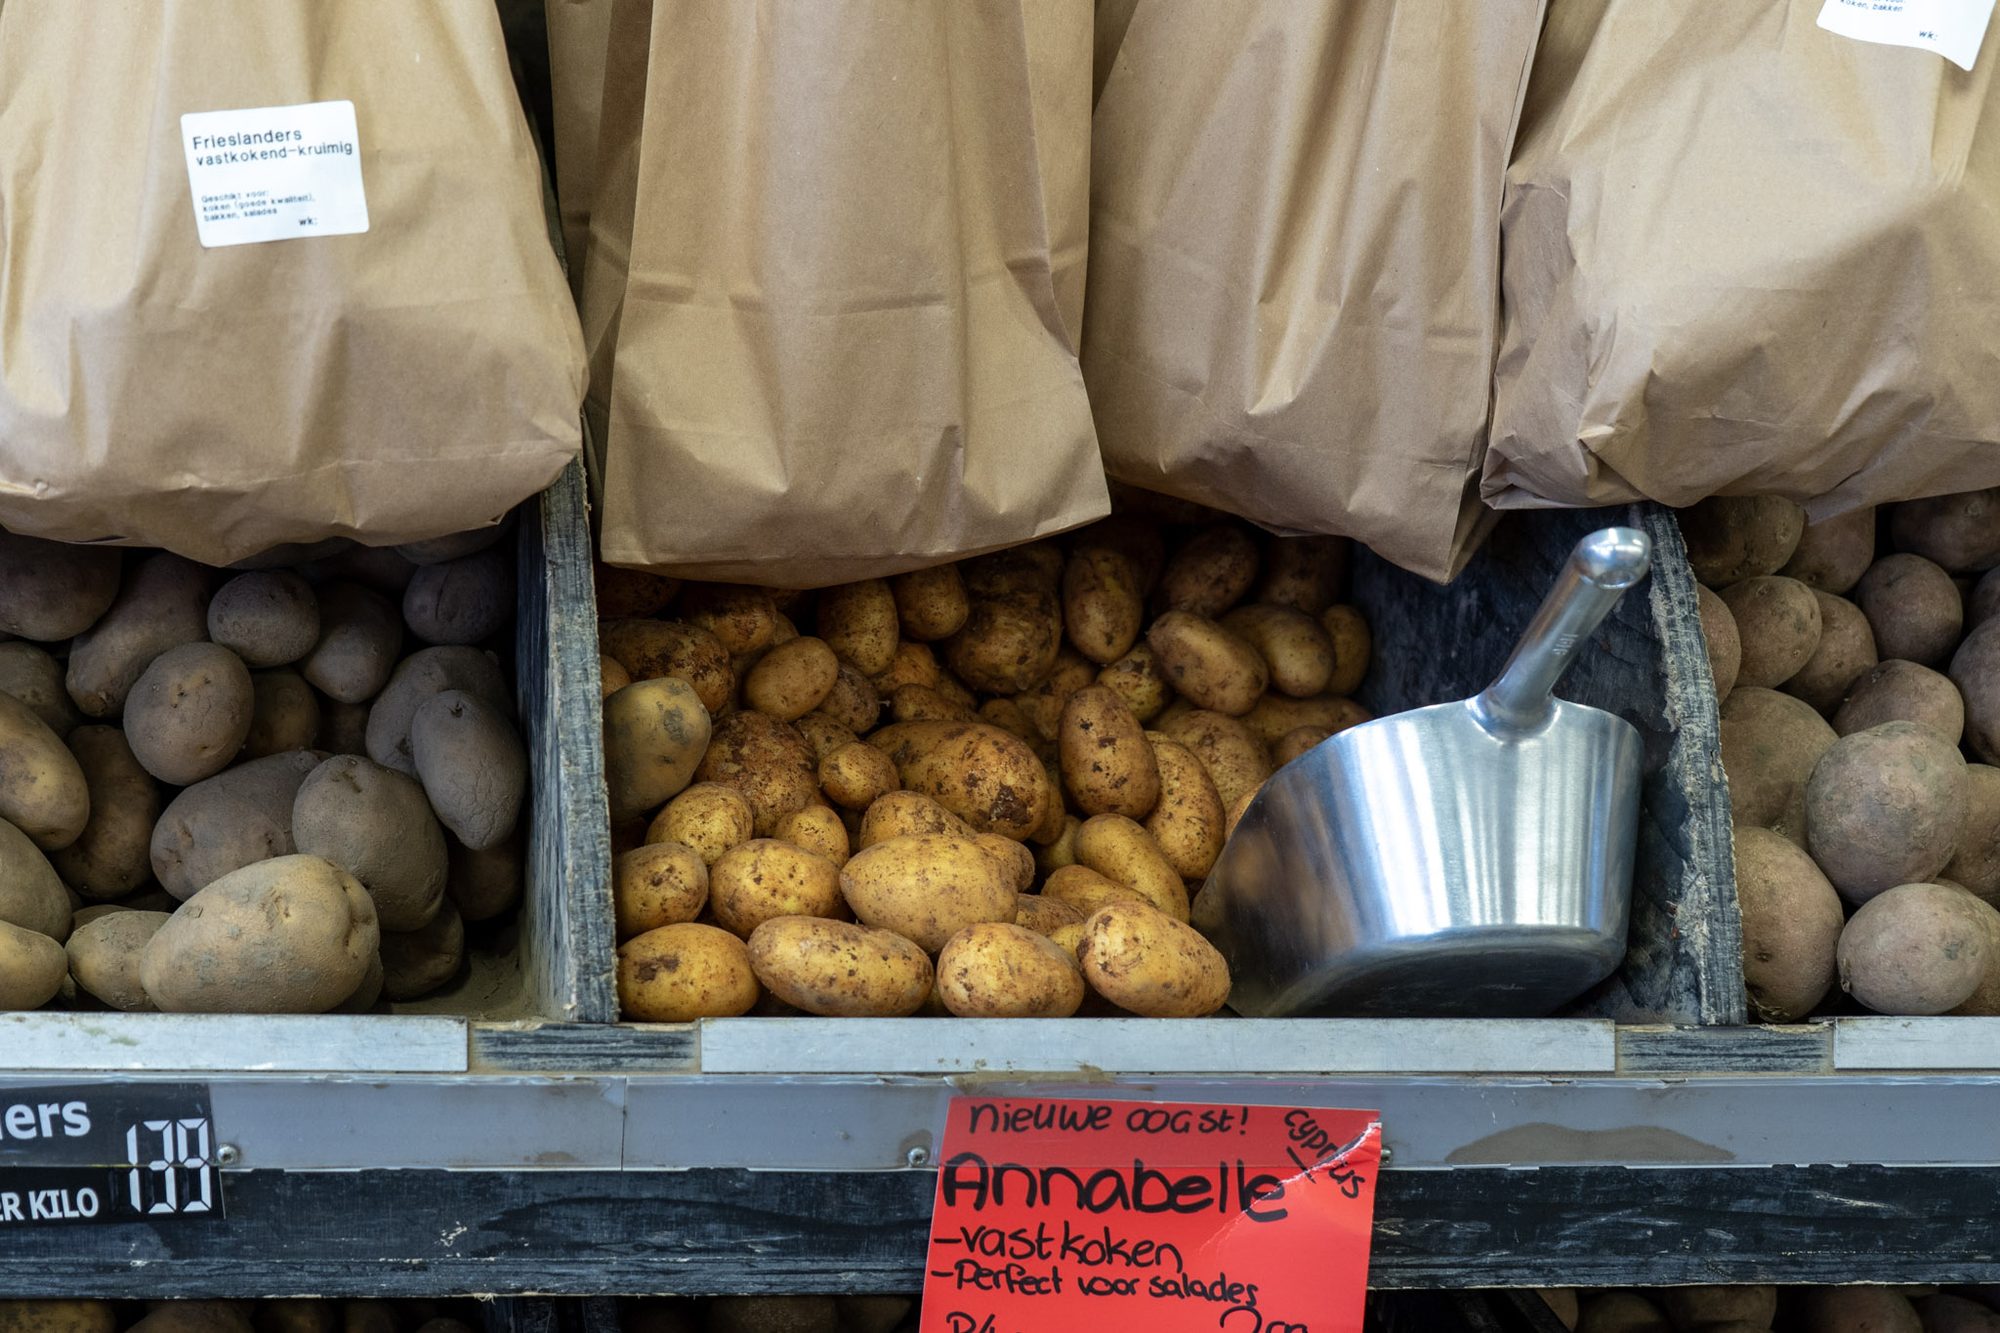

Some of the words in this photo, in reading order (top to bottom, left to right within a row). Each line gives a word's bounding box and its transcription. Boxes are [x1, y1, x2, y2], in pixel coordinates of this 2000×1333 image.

[1919, 30, 1939, 40] wk:
[193, 129, 302, 150] Frieslanders
[196, 141, 353, 166] vastkokend-kruimig
[203, 203, 231, 213] koken
[234, 199, 267, 210] (goede
[244, 207, 278, 218] salades
[299, 217, 318, 226] wk:
[0, 1100, 92, 1140] ers
[942, 1152, 1288, 1222] Annabelle
[0, 1191, 25, 1222] R
[28, 1187, 99, 1218] KILO
[1077, 1276, 1140, 1297] voor
[1148, 1271, 1259, 1308] salades
